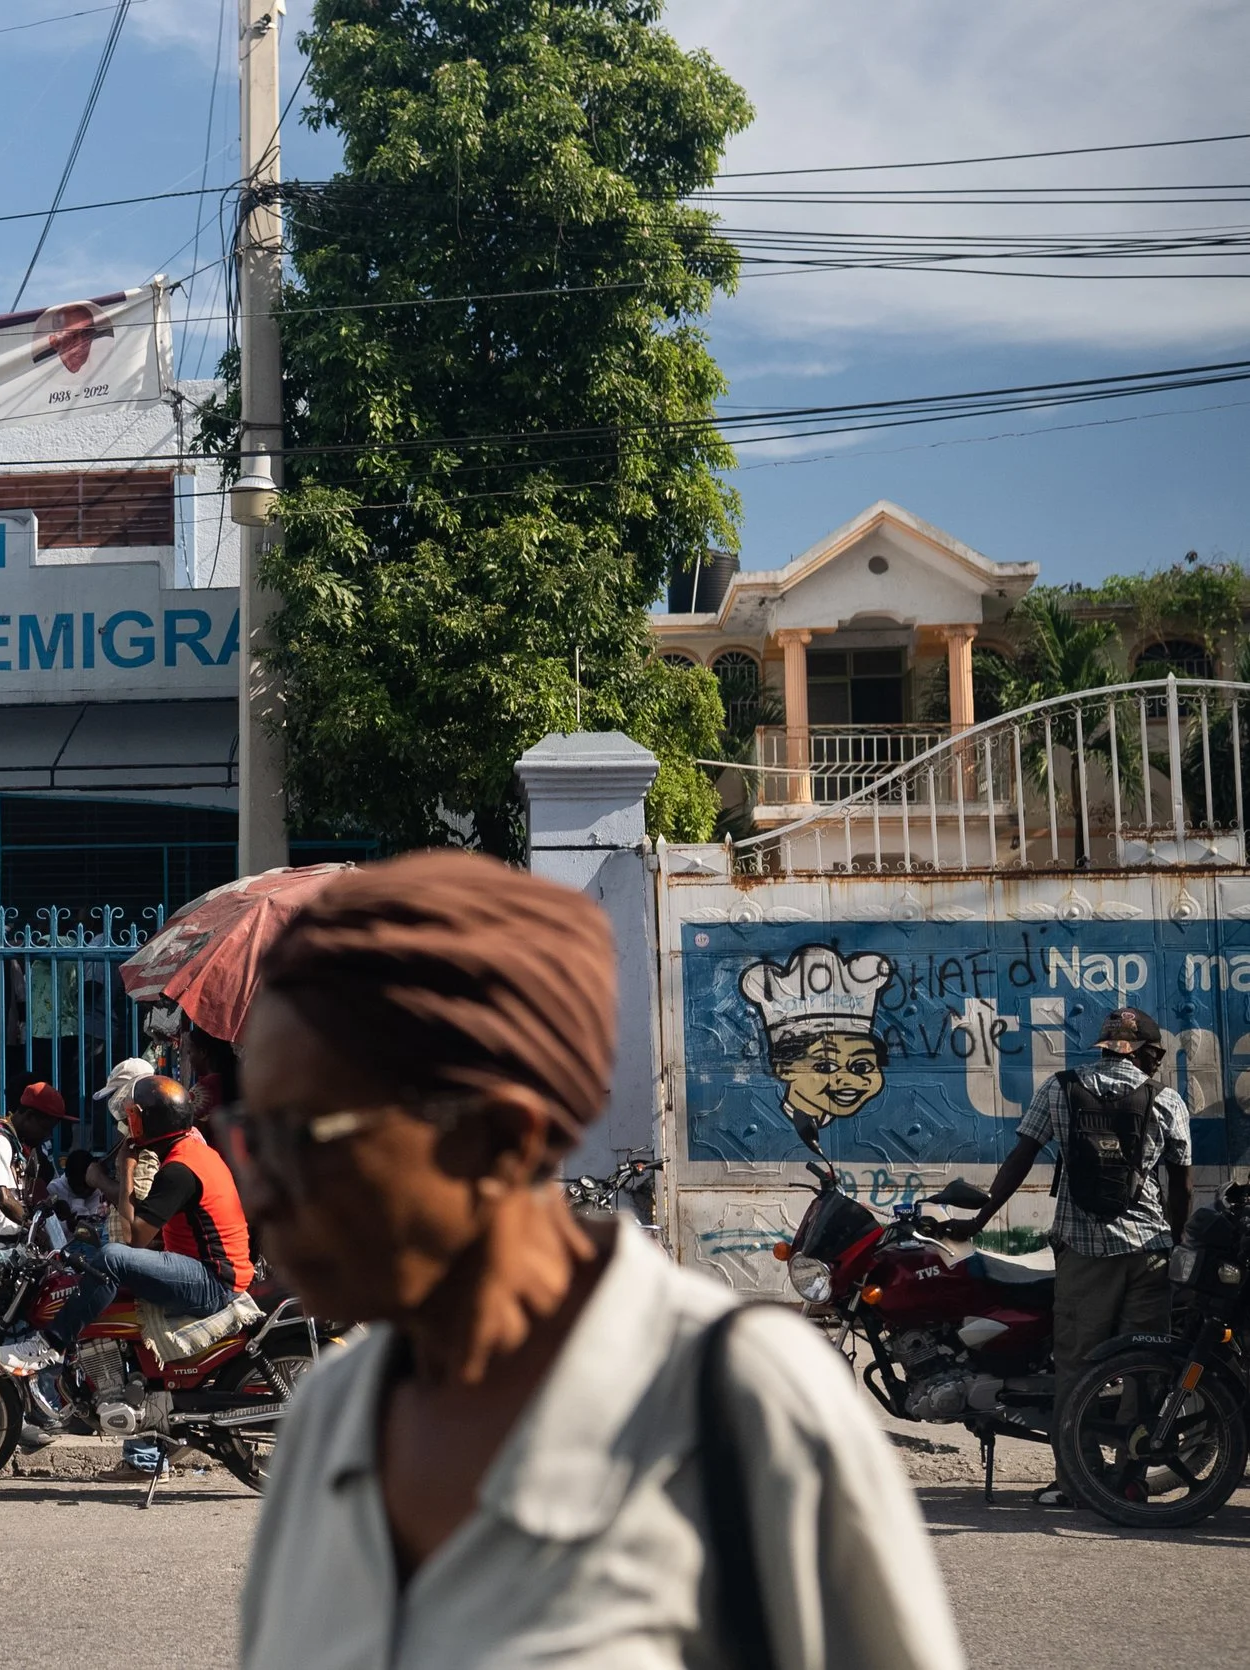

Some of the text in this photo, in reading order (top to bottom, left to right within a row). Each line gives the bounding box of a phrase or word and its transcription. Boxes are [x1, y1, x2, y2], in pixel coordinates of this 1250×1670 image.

[48, 389, 71, 404] 1938
[83, 384, 109, 399] 2022
[1049, 945, 1148, 1008] Nap
[915, 1265, 941, 1281] TVS
[1132, 1334, 1172, 1344] APOLLO
